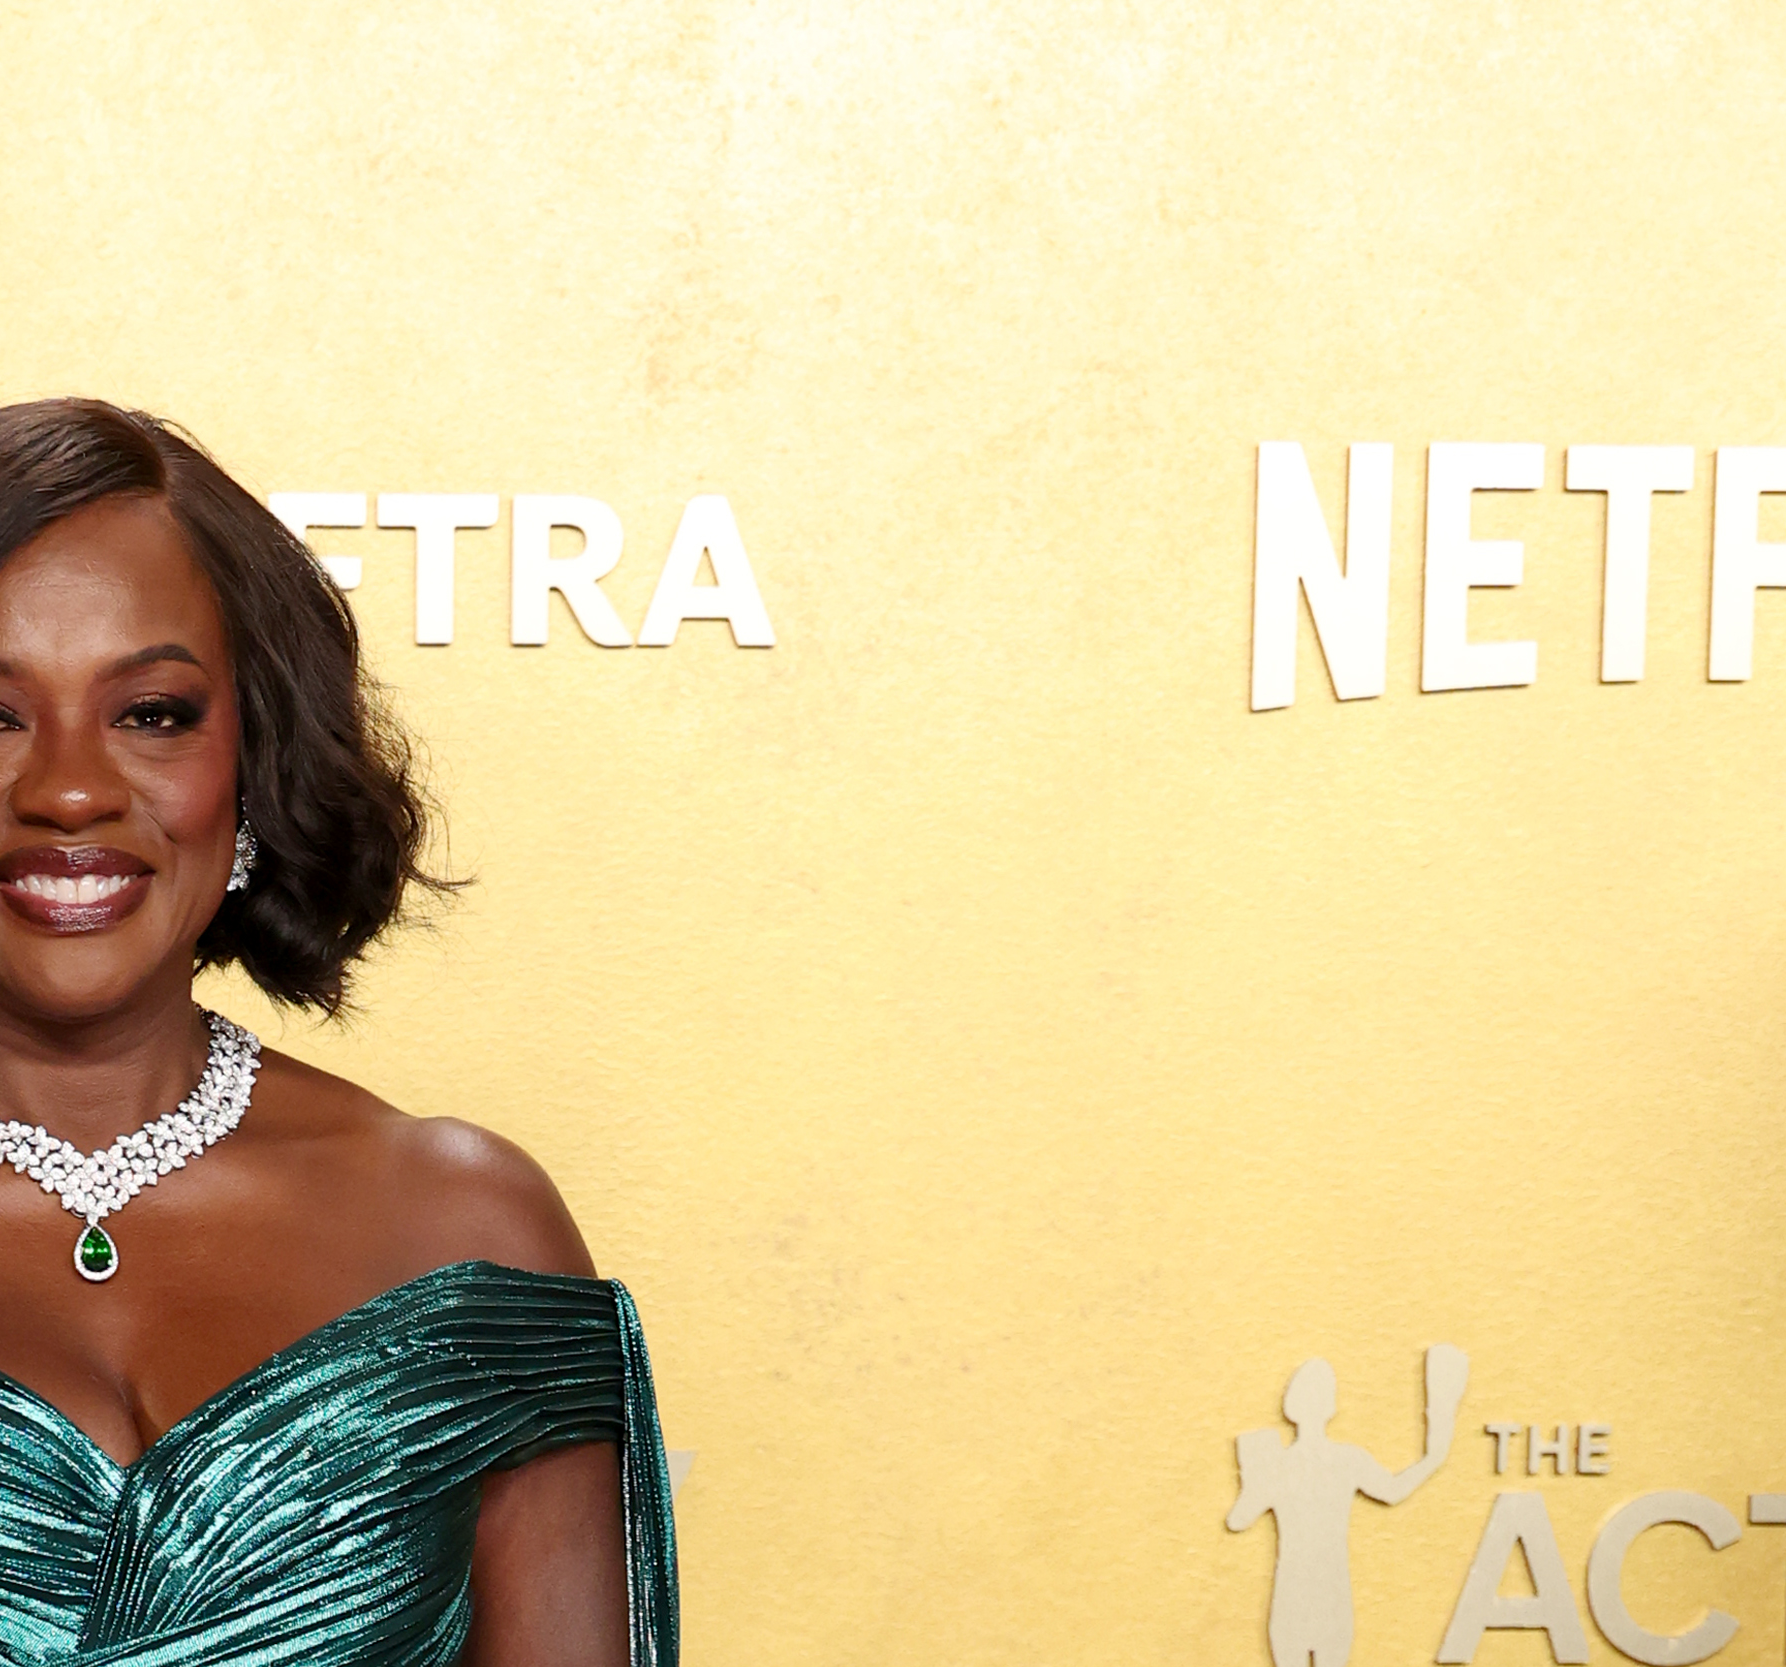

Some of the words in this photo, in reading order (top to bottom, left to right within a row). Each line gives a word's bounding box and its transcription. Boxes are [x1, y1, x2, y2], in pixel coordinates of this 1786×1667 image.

[1250, 440, 1786, 712] NETF
[1484, 1424, 1611, 1475] THE
[1434, 1490, 1786, 1667] AC
